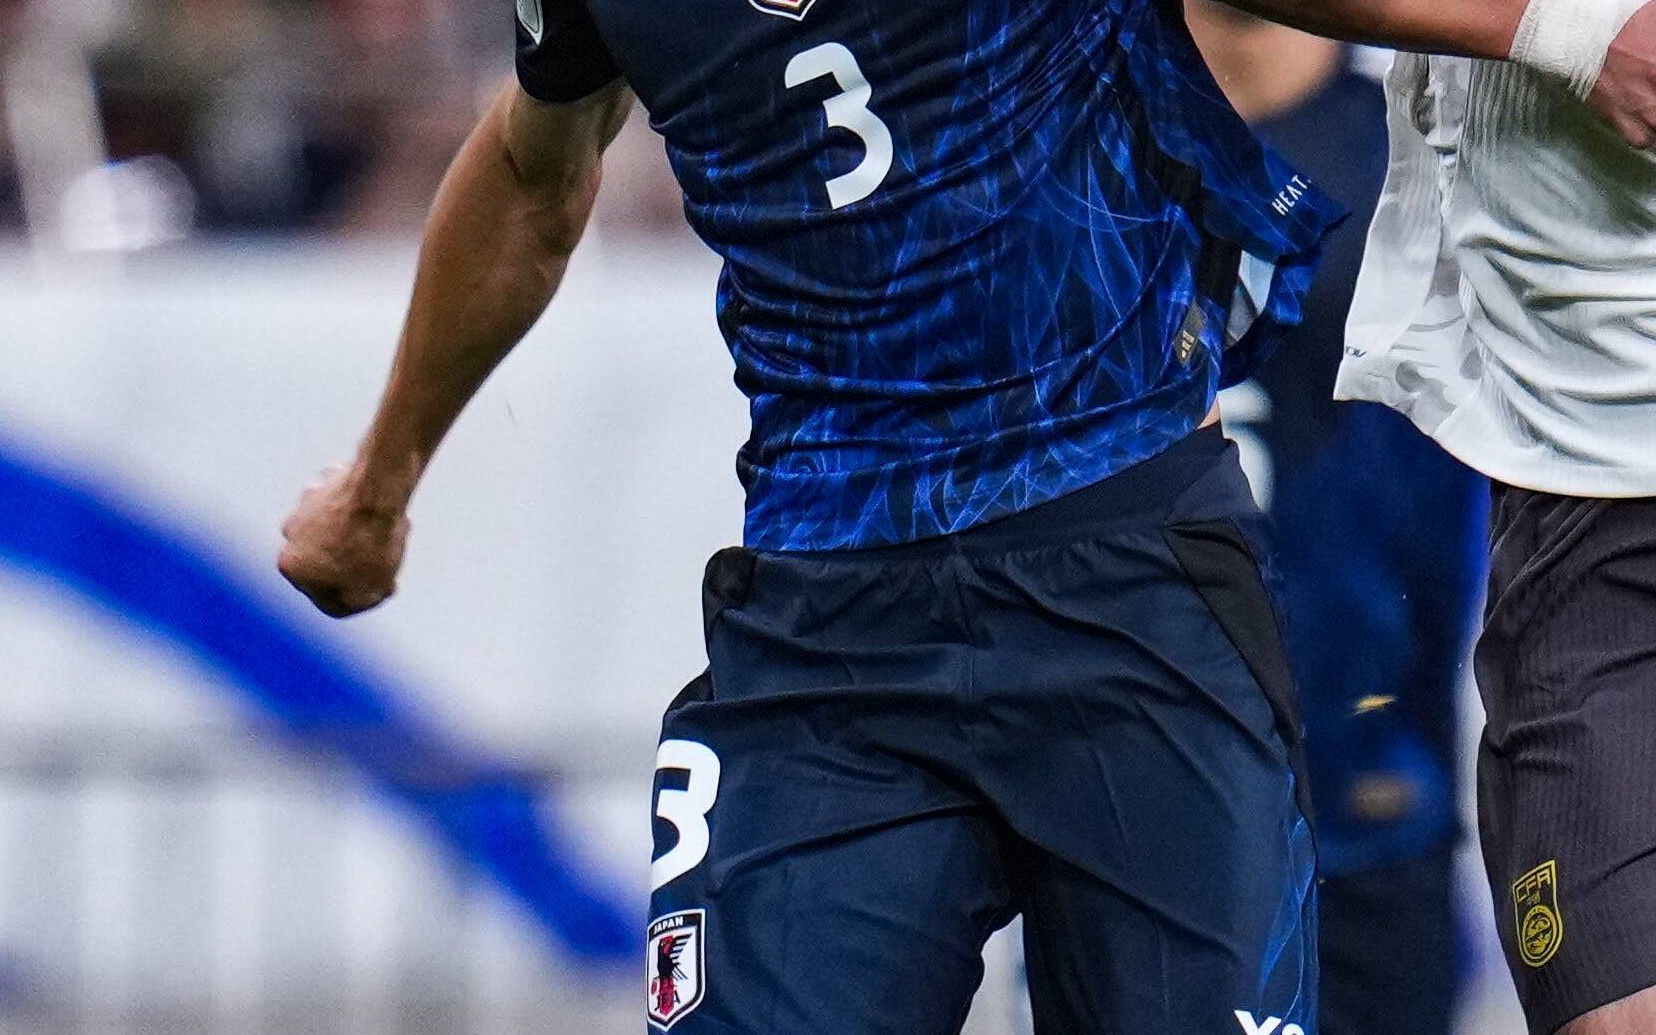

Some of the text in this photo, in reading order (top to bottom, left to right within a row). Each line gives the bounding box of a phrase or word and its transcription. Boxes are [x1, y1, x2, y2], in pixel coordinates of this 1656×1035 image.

[784, 42, 894, 210] 3
[650, 739, 721, 894] 3
[653, 915, 684, 935] JAPAN
[1515, 867, 1551, 903] CFA
